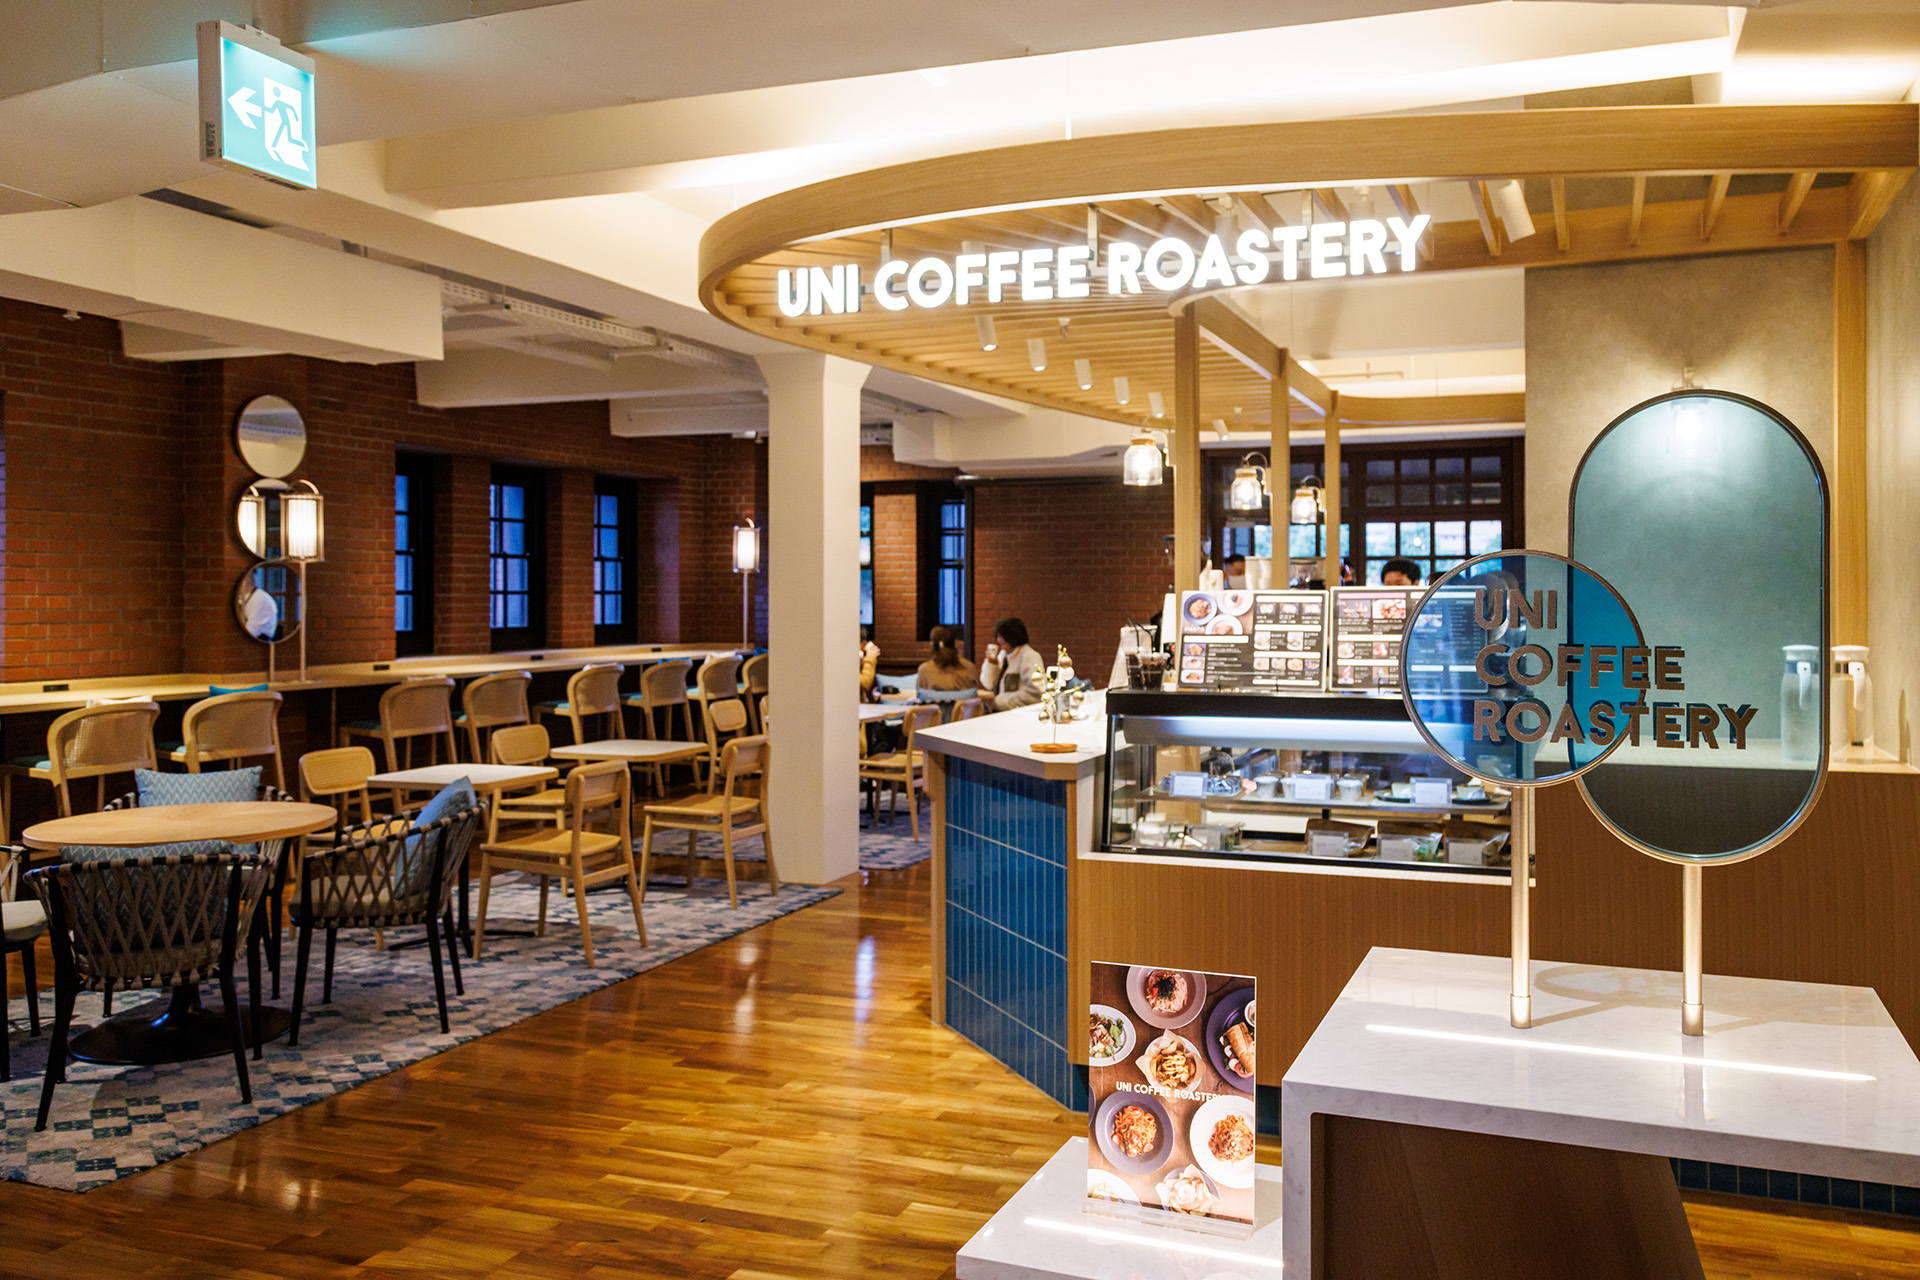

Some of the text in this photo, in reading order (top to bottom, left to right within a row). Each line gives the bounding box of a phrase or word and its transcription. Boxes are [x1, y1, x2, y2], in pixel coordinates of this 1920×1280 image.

[777, 214, 1431, 317] UNI COFFEE ROASTERY
[1474, 589, 1558, 630] UNI
[1475, 644, 1686, 691] COFFEE
[1473, 700, 1759, 750] ROASTERY
[1116, 1081, 1132, 1092] UNI
[1134, 1084, 1172, 1098] COFFEE
